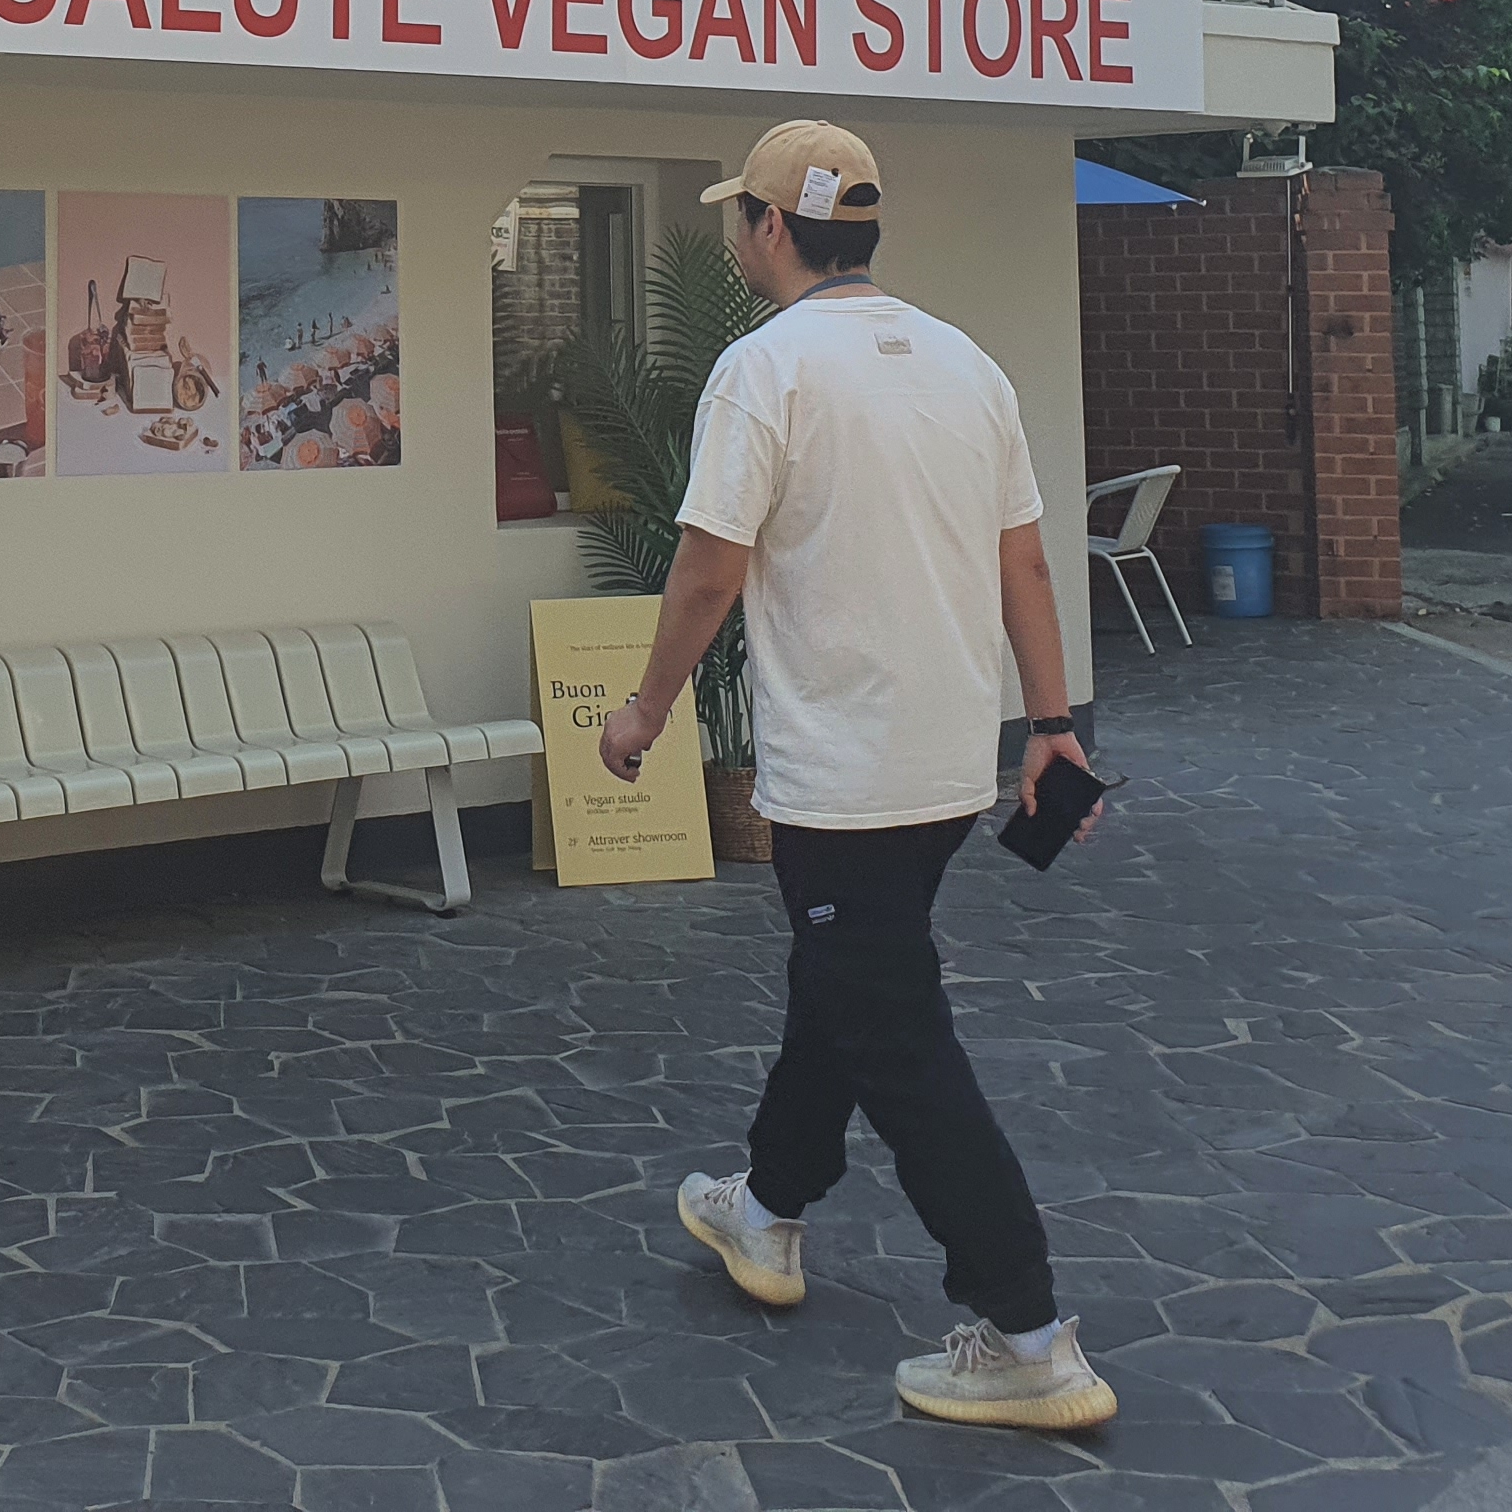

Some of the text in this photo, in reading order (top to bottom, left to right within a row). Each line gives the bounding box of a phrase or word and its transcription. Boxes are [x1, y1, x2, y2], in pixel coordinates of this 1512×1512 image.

[550, 680, 607, 699] Buon
[583, 794, 616, 807] Vegan
[617, 792, 651, 804] studio
[588, 835, 630, 846] Attraver
[632, 831, 688, 844] showroom
